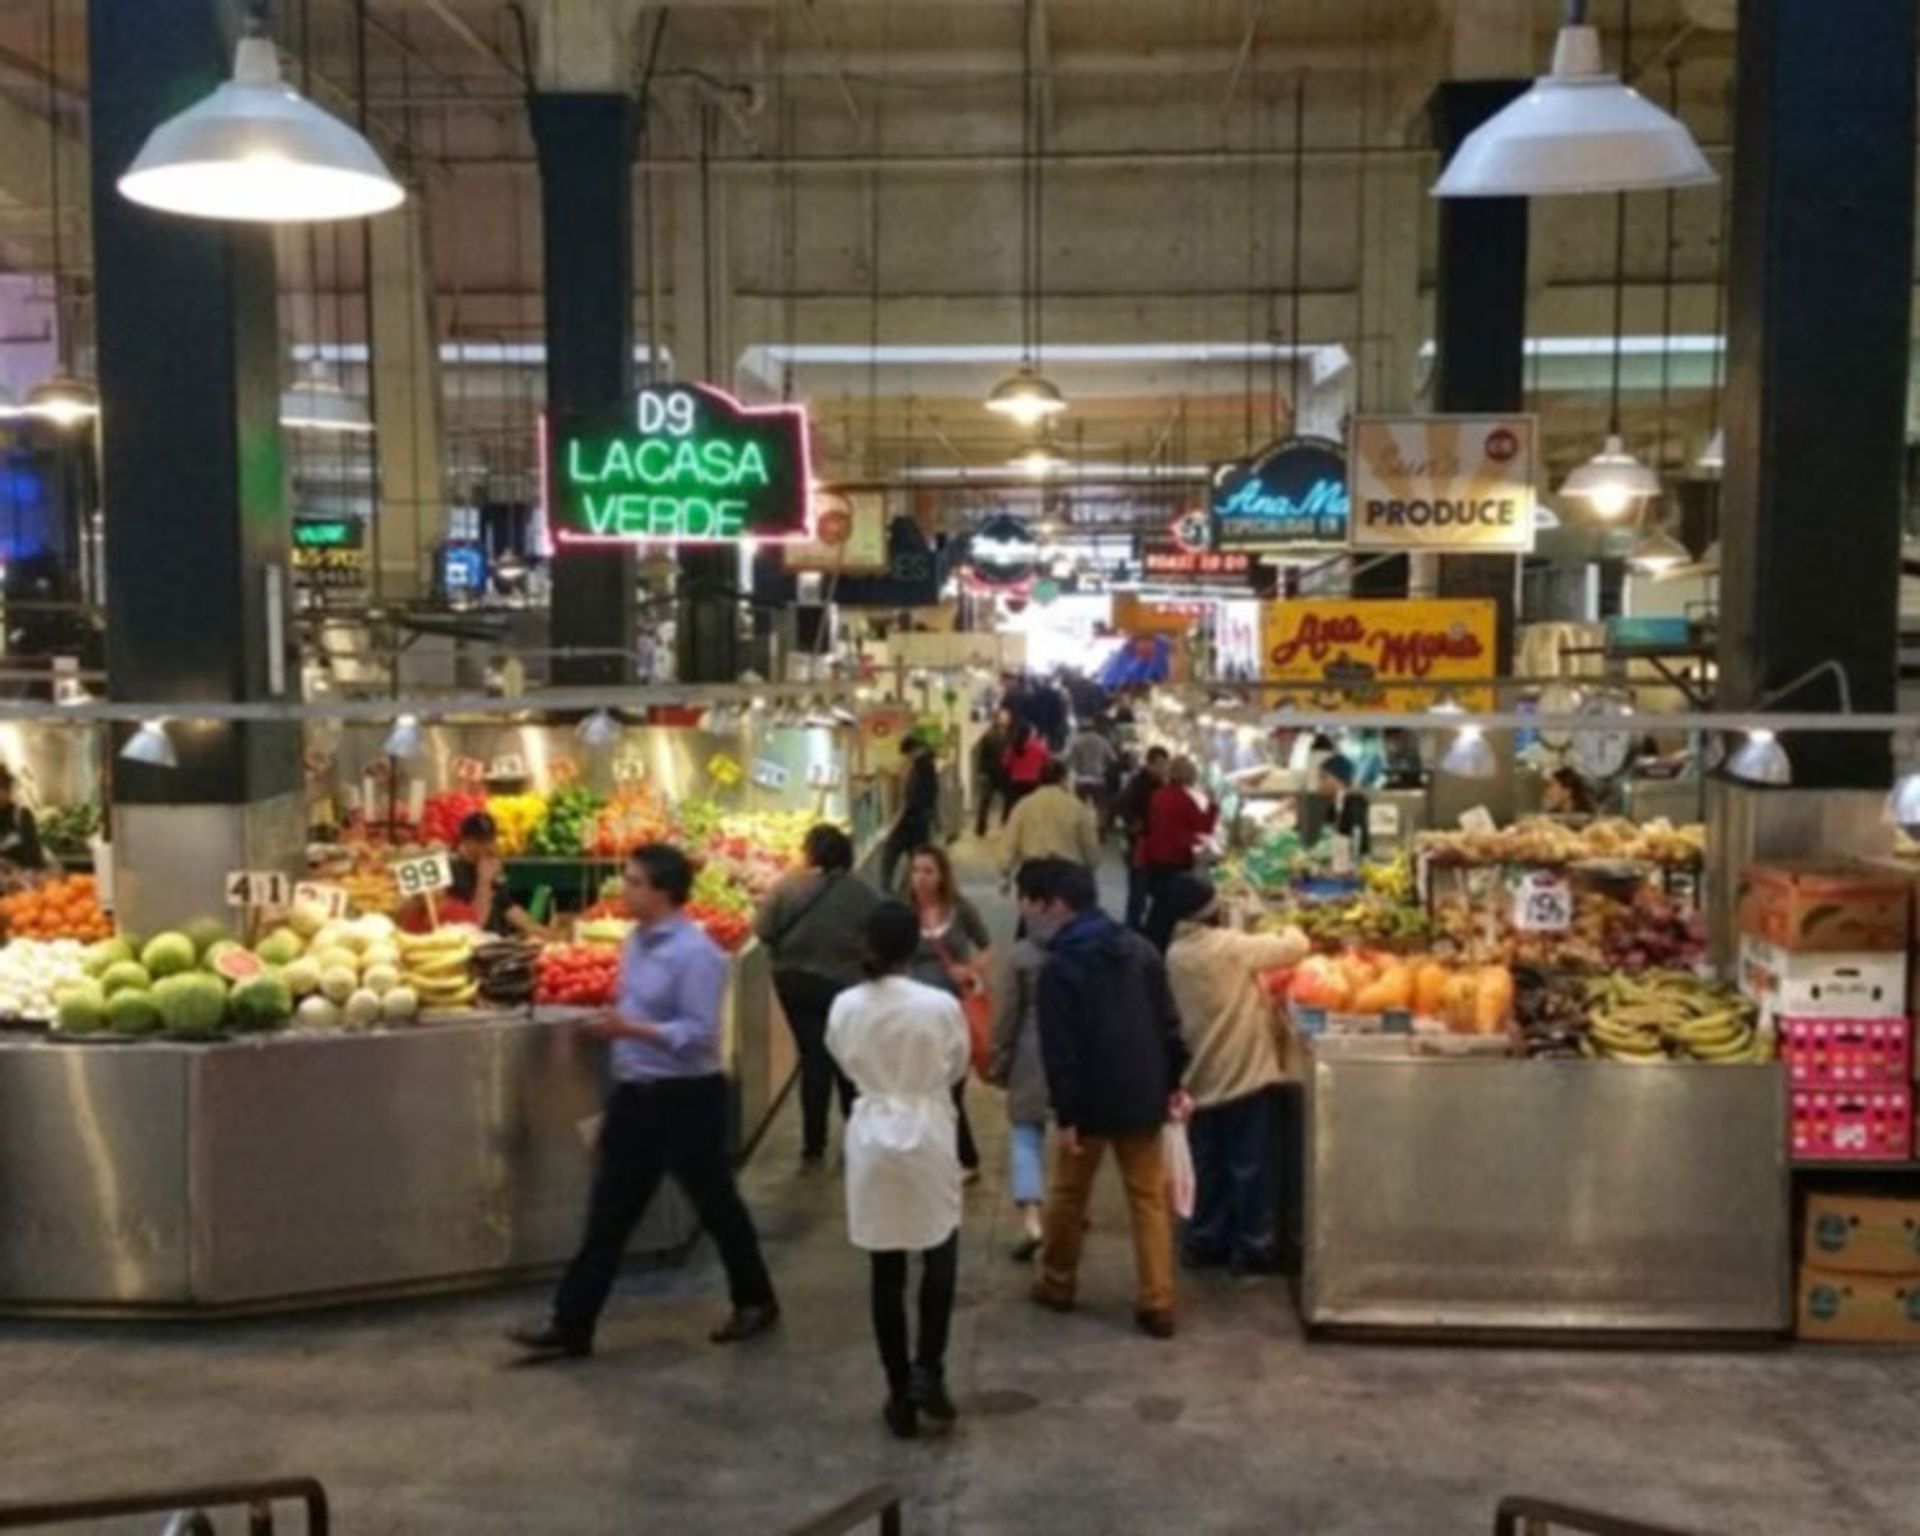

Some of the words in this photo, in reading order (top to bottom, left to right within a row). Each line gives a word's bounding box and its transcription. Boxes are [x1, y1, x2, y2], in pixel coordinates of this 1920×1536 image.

[638, 391, 695, 436] D9
[583, 493, 748, 537] VERDE
[1213, 479, 1290, 515] Ana
[1366, 499, 1515, 526] PRODUCE
[1271, 614, 1365, 666] Ana
[401, 859, 441, 890] 99
